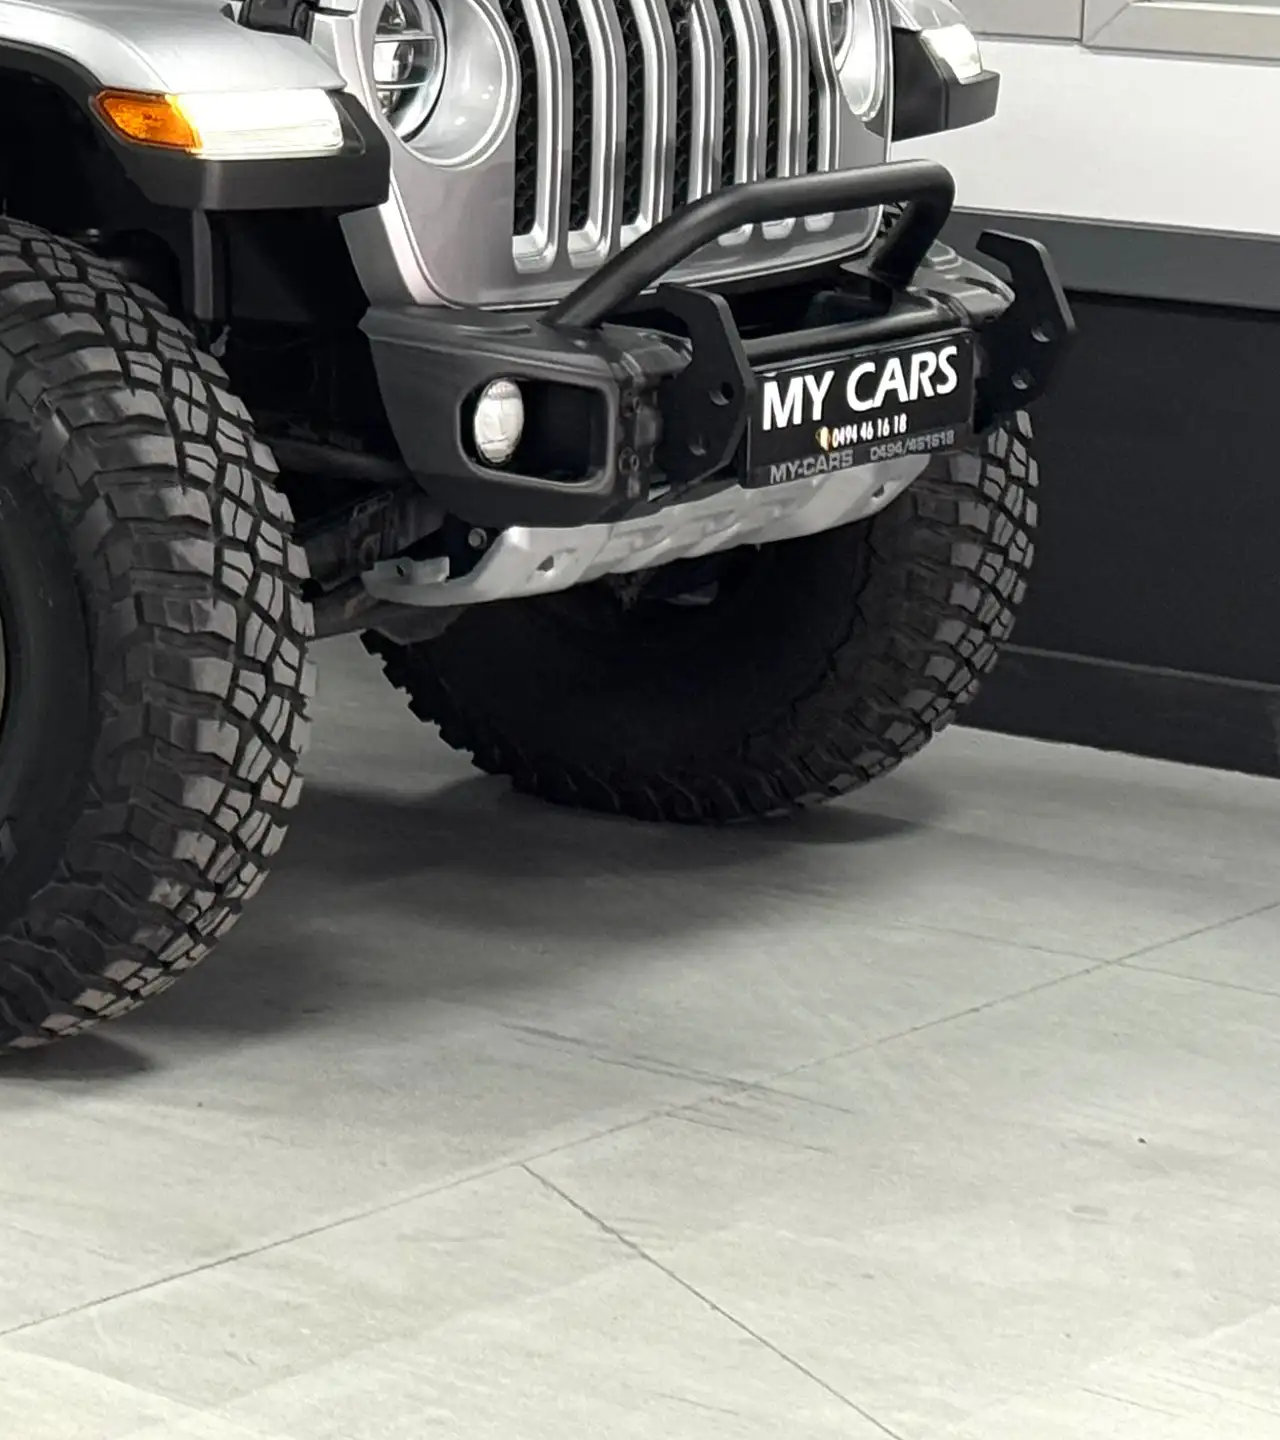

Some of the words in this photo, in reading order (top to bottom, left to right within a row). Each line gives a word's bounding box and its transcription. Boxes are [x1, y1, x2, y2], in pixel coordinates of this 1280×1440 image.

[762, 370, 835, 431] MY
[846, 345, 958, 412] CARS
[831, 424, 858, 449] 0494
[860, 420, 874, 442] 46
[876, 417, 891, 439] 16
[893, 413, 908, 435] 18
